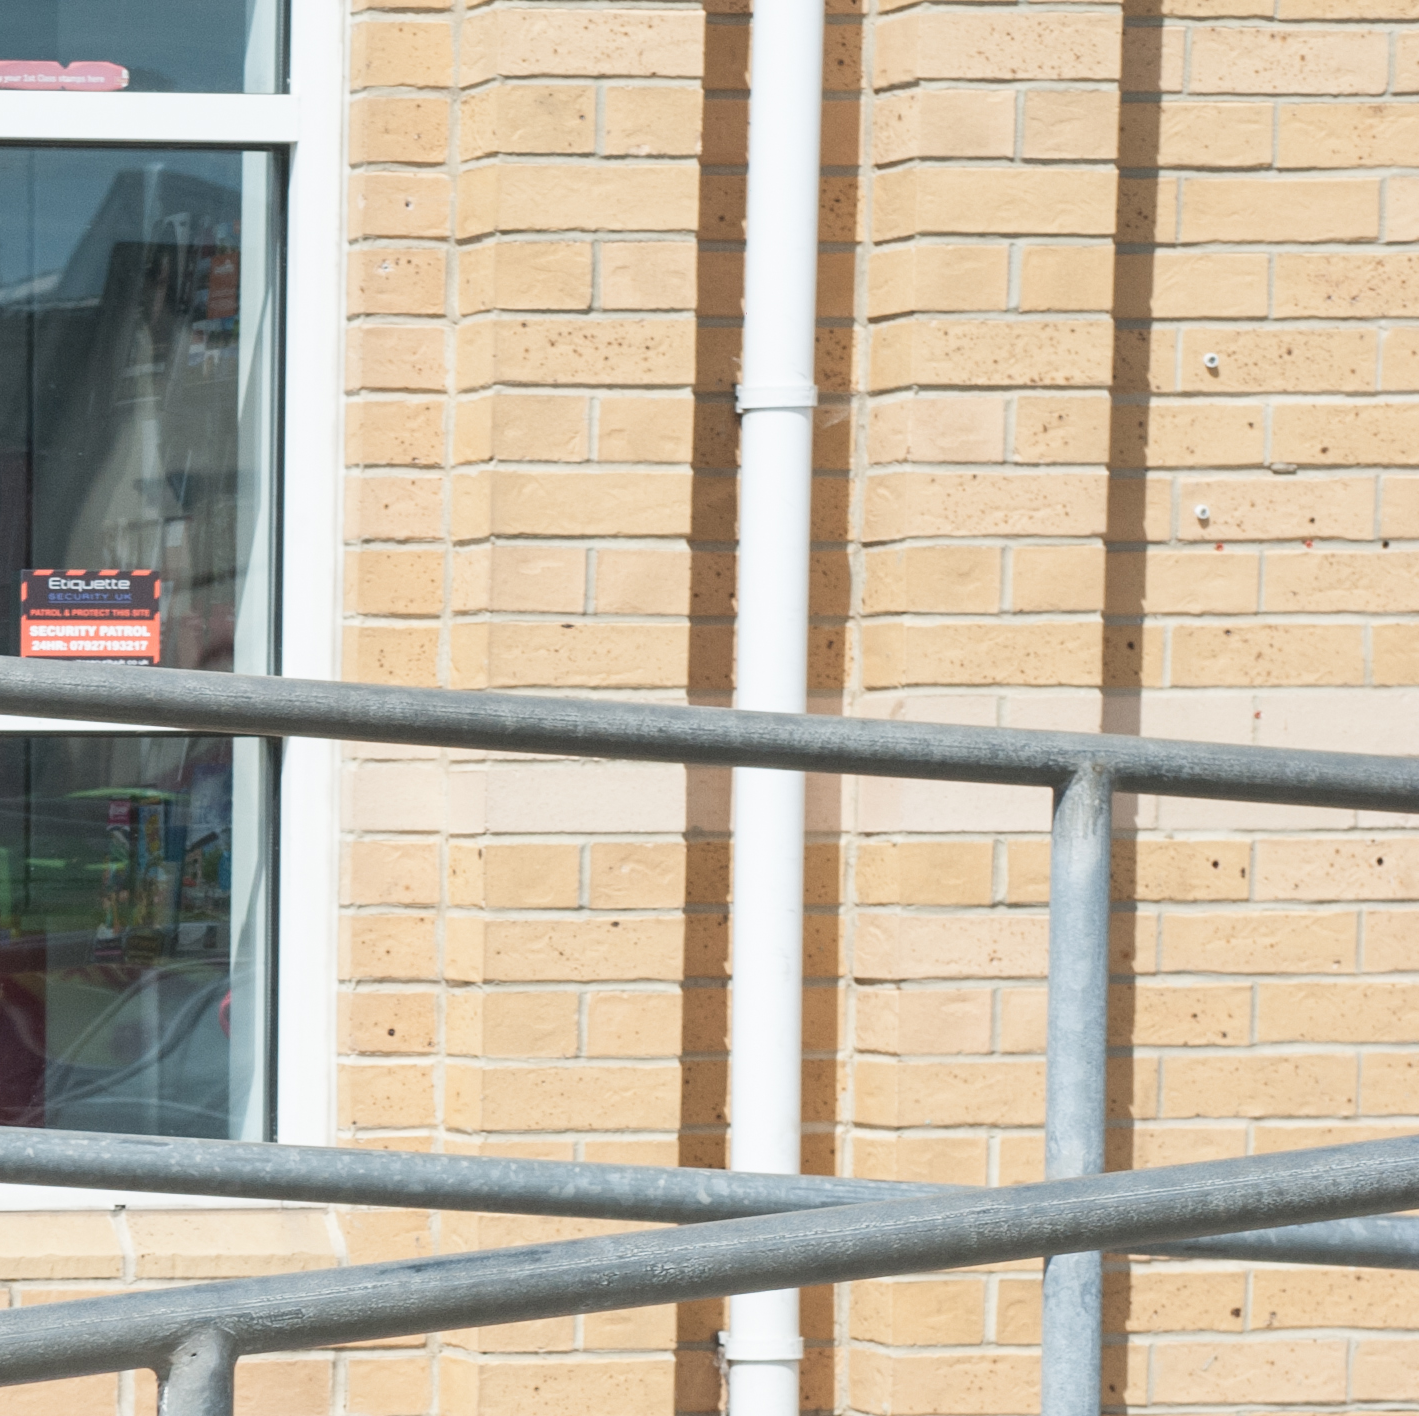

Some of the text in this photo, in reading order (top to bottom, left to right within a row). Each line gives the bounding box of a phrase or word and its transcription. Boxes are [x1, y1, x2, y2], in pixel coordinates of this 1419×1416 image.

[4, 75, 21, 83] your
[23, 74, 36, 82] 1st
[38, 74, 56, 82] Class
[58, 75, 85, 83] stamps
[48, 577, 131, 591] Etiquette
[30, 609, 150, 617] PATROL & PROTECT THIS SITE
[29, 625, 151, 637] SECURITY PATROL
[31, 640, 68, 651] 24HR:
